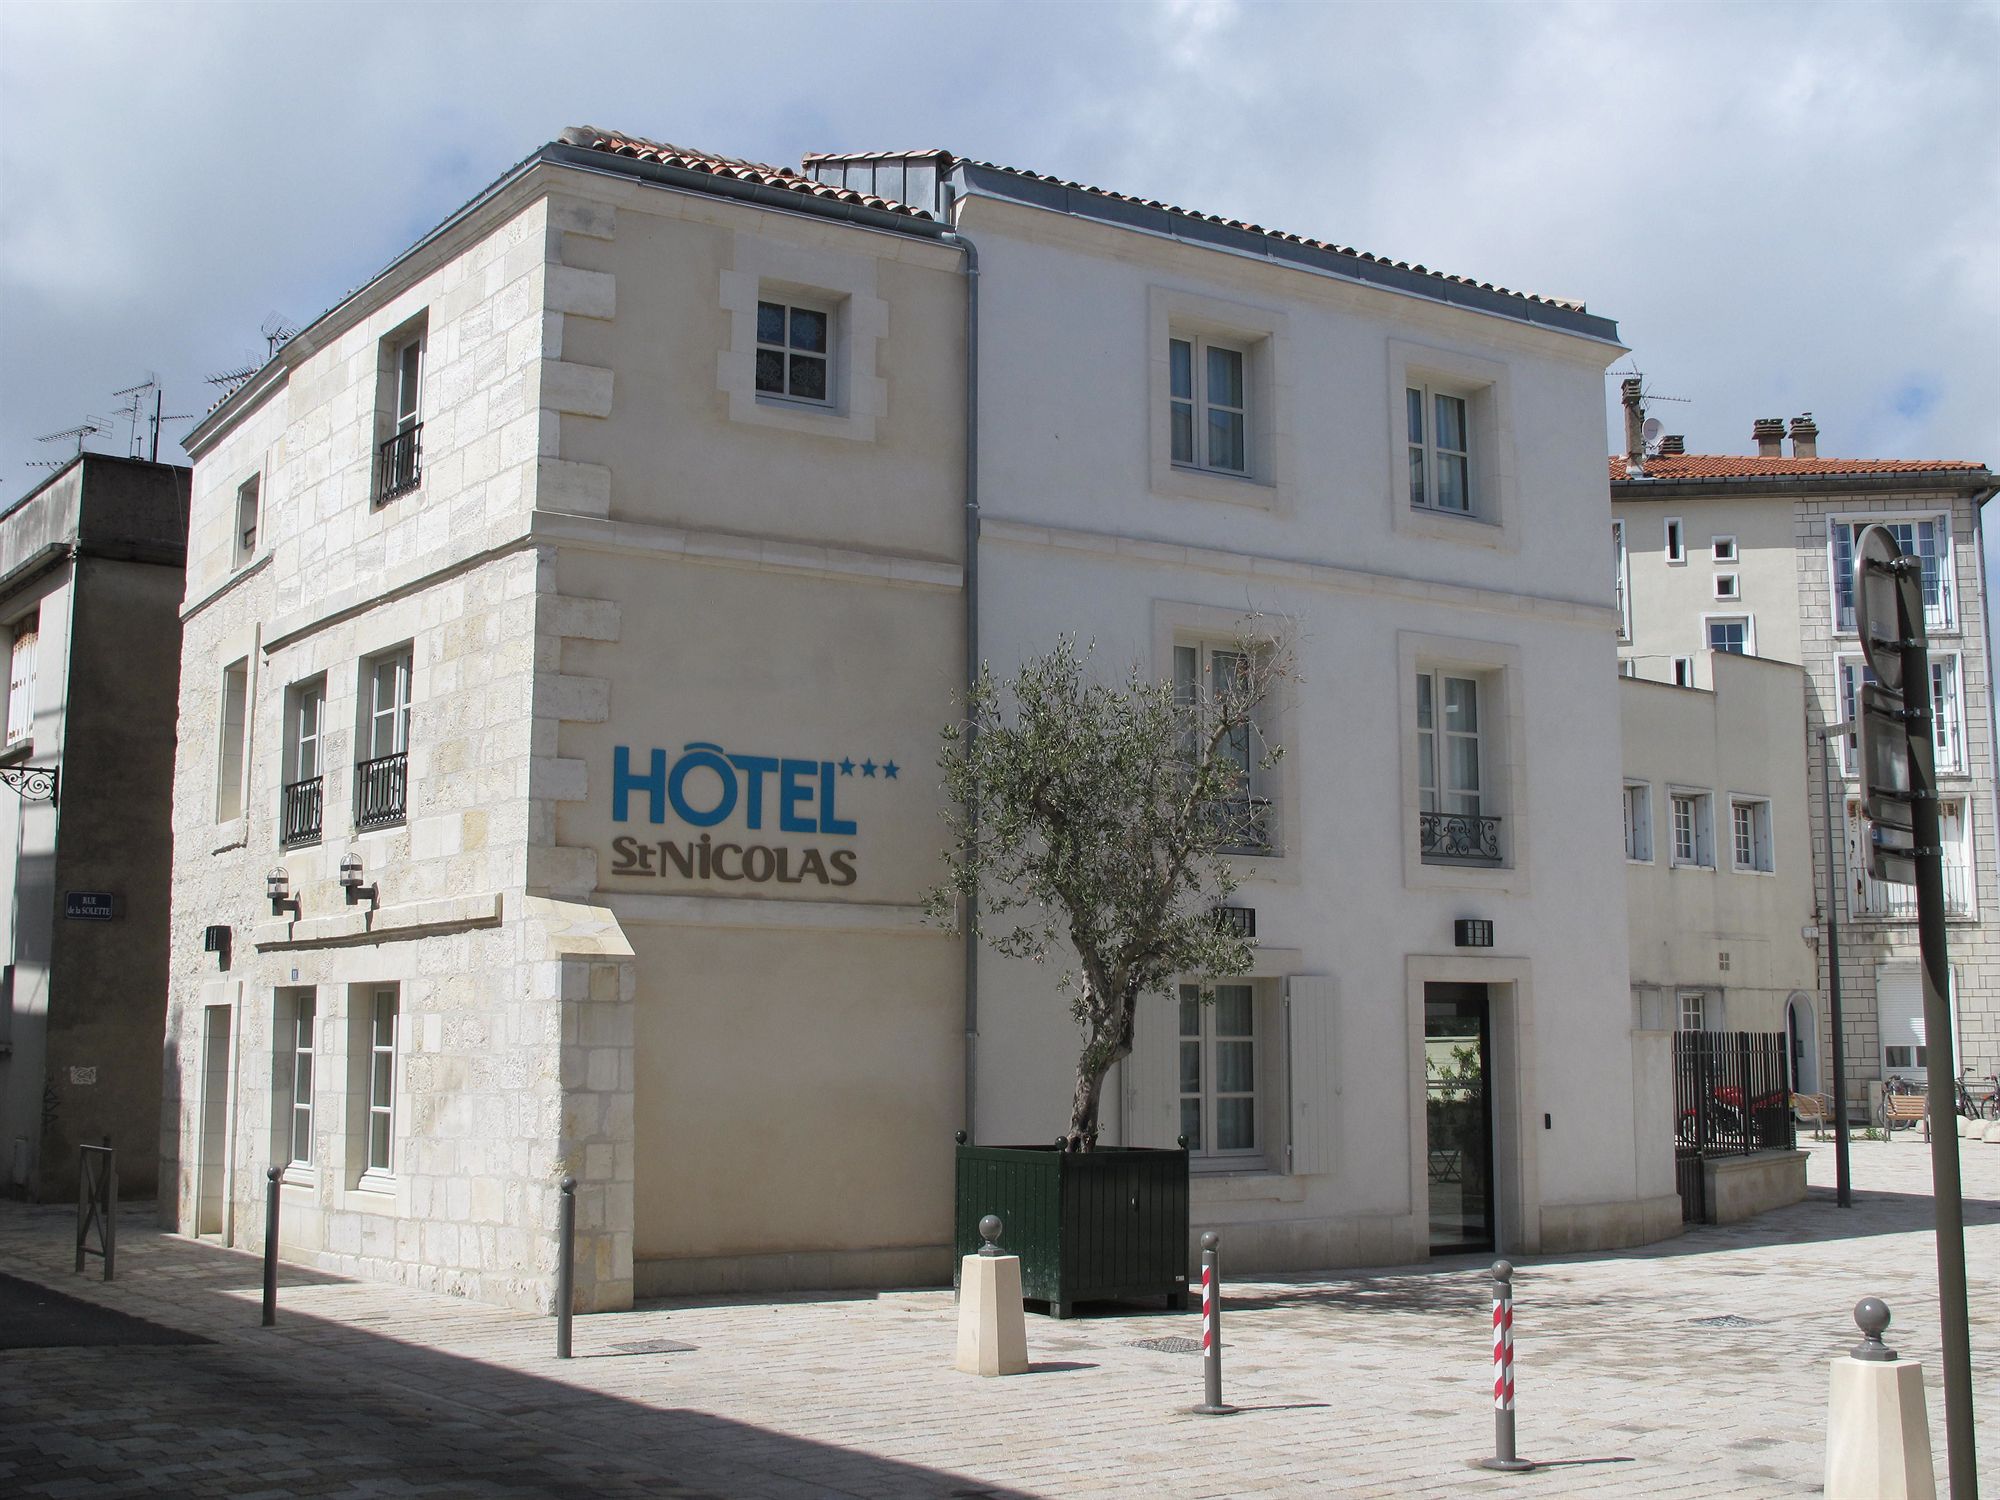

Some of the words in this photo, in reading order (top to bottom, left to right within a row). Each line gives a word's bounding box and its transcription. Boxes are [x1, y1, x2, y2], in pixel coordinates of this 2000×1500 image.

[612, 742, 858, 836] HÔTEL
[611, 836, 657, 877] St
[82, 896, 97, 905] RUE
